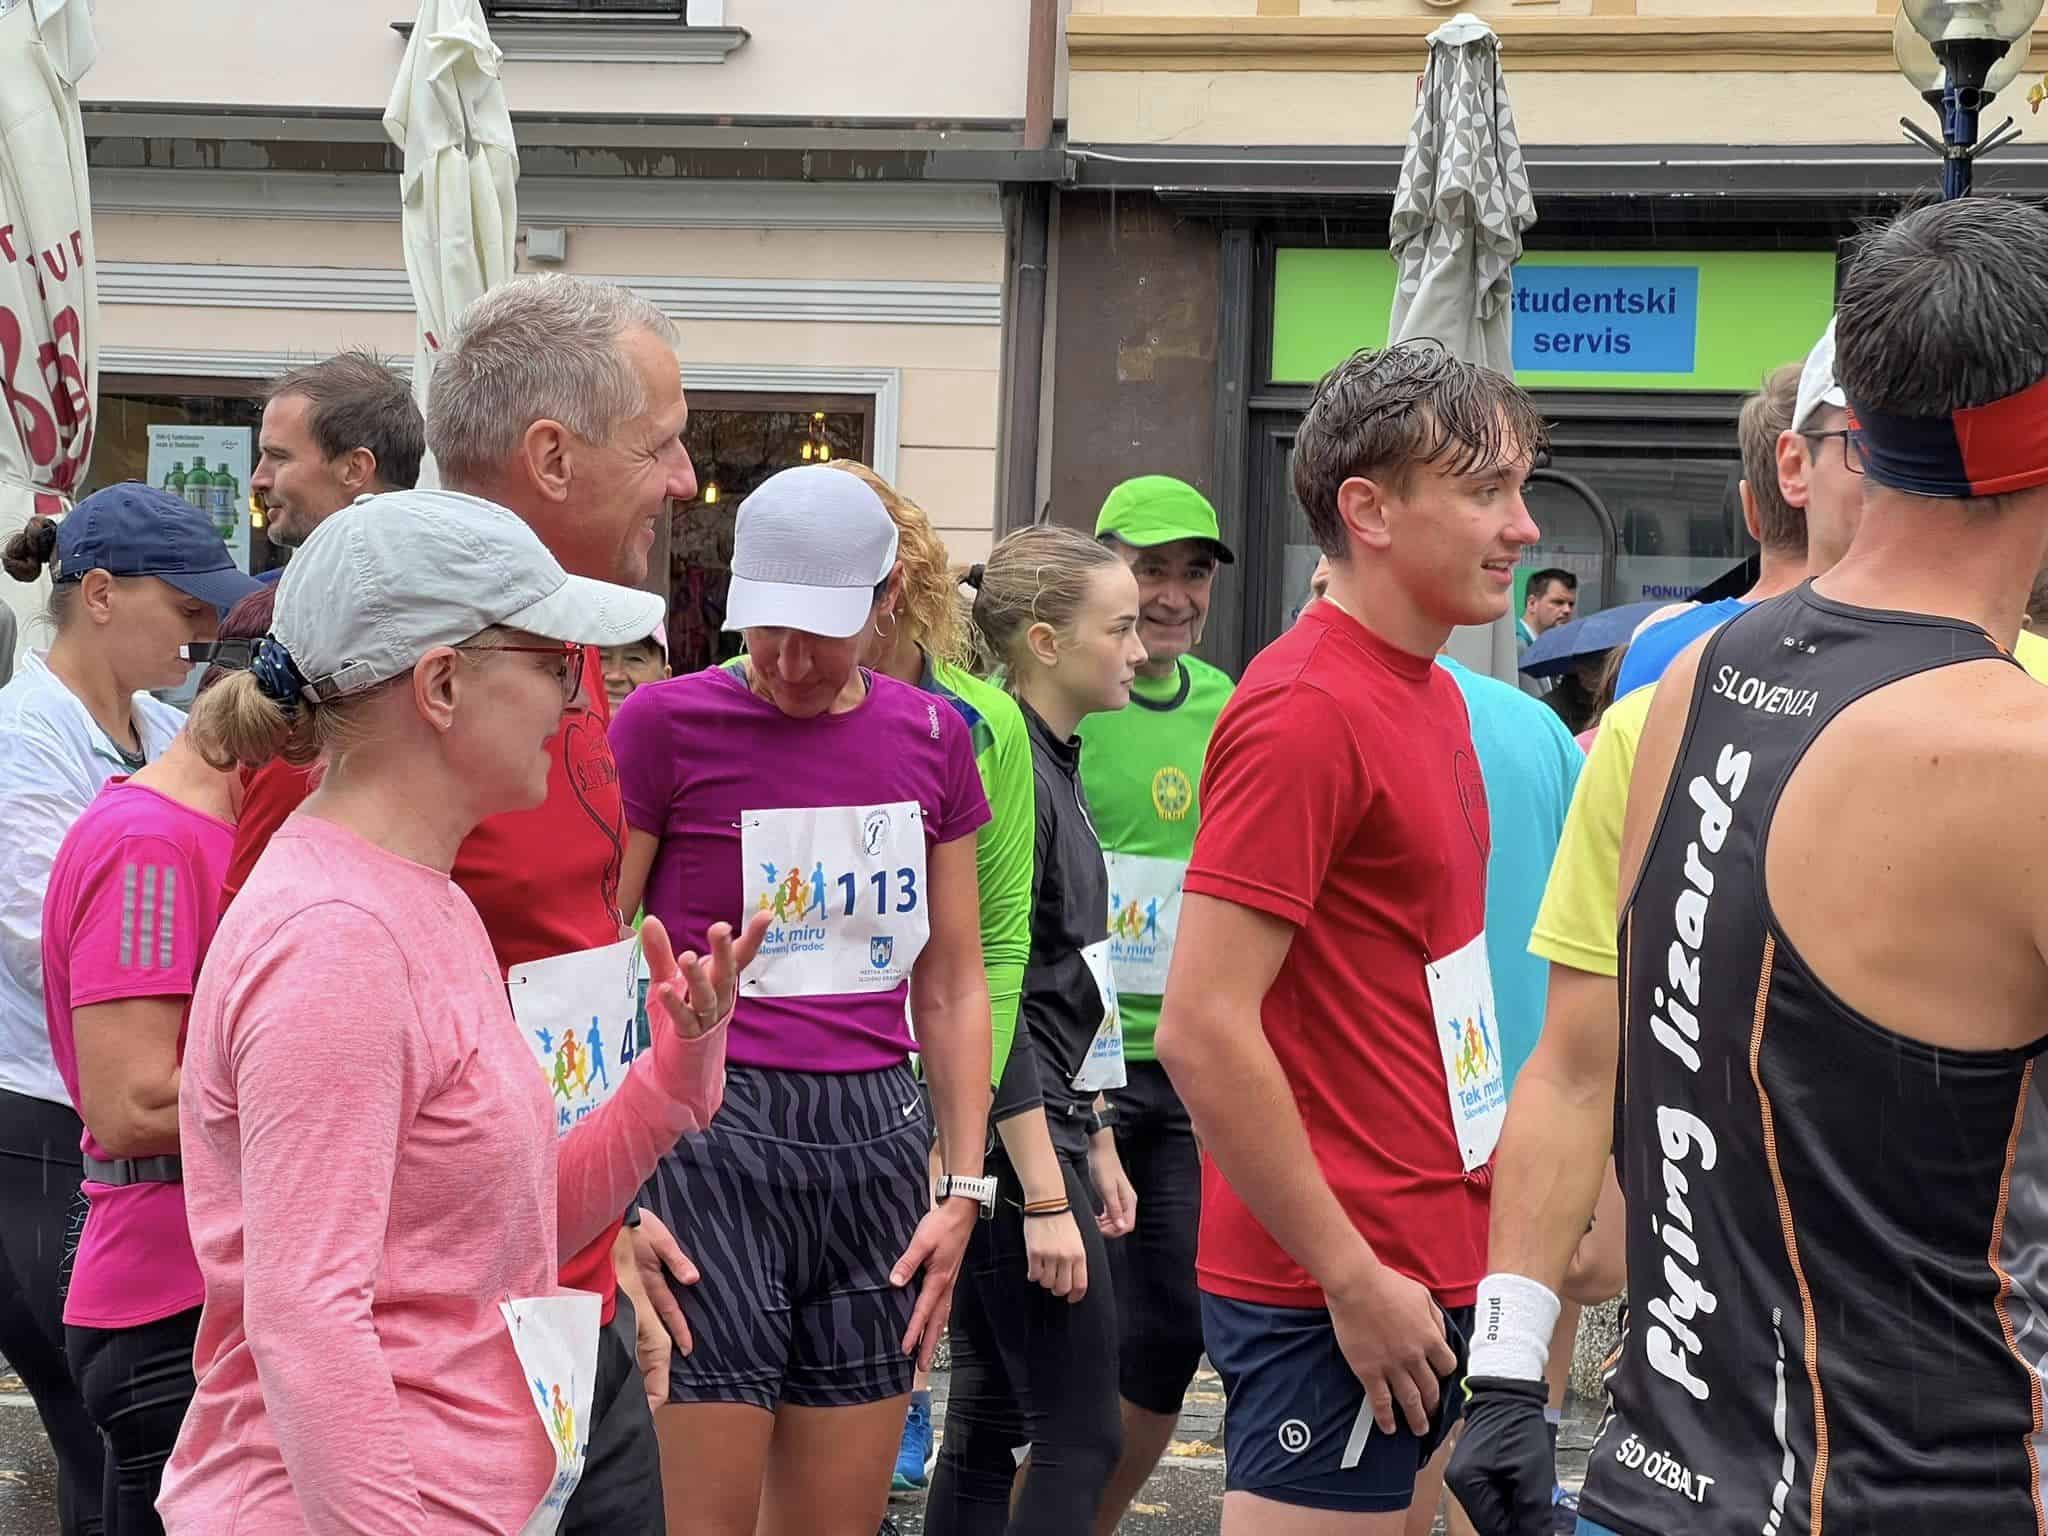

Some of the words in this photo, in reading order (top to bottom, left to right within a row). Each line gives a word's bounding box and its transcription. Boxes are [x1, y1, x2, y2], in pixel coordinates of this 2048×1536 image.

[1512, 287, 1677, 314] tudentski
[1533, 328, 1631, 354] servis
[1642, 584, 1701, 598] PONUD
[1713, 665, 1819, 717] SLOVENIA
[927, 704, 940, 739] Reebok
[838, 867, 918, 916] 113
[1650, 743, 1752, 1073] lizards
[765, 927, 785, 943] ek
[789, 924, 825, 942] miru
[1458, 1084, 1482, 1108] Tek
[1487, 1297, 1505, 1341] prince
[1615, 1433, 1646, 1469] ŠD
[1643, 1450, 1716, 1503] OŽBALT
